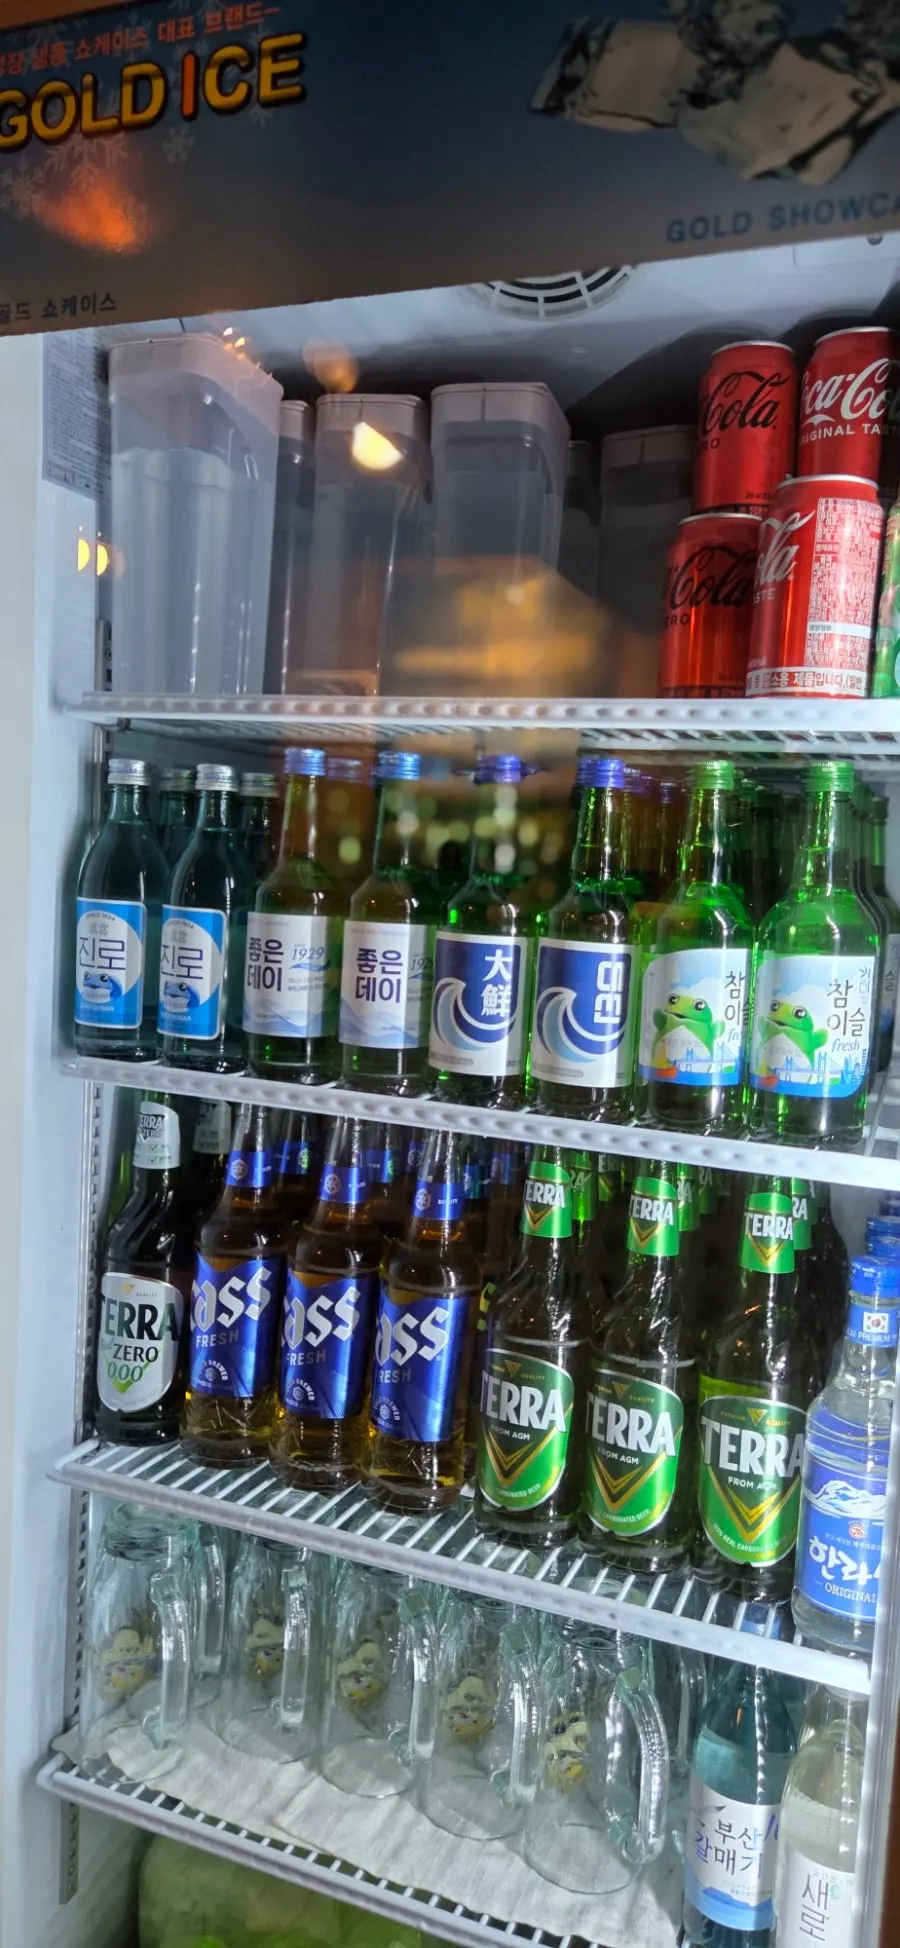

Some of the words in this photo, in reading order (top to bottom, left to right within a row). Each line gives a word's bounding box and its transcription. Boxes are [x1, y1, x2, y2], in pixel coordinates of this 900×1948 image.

[75, 27, 149, 60] 쇼케이스
[158, 16, 196, 43] 대표
[0, 61, 168, 150] GOLD
[181, 32, 306, 118] ICE
[666, 211, 753, 244] GOLD
[41, 292, 117, 318] 쇼케이스
[801, 424, 855, 445] RIGINAL
[79, 937, 126, 971] 진로
[160, 944, 204, 980] 진로
[248, 937, 284, 964] 좋은
[291, 946, 325, 961] 1929
[356, 947, 403, 975] 좋은
[247, 964, 282, 992] 데이
[355, 976, 402, 1003] 데이
[481, 949, 515, 1018] 大鮮
[831, 1038, 860, 1053] fresh
[525, 1179, 566, 1208] TERRA
[629, 1194, 675, 1226] TERRA
[744, 1211, 794, 1240] TERRA
[196, 1329, 239, 1349] FRESH
[374, 1306, 450, 1367] ass
[112, 1343, 159, 1364] ZERO
[378, 1369, 412, 1384] RESH
[490, 1424, 511, 1437] FROM
[512, 1430, 531, 1441] AGM
[701, 1415, 805, 1478] TERRA
[597, 1446, 618, 1461] FROM
[619, 1454, 640, 1465] AGM
[728, 1476, 755, 1489] FROM
[809, 1535, 881, 1586] 한라
[824, 1582, 878, 1603] ORIGINAL
[713, 1818, 763, 1851] 부산
[694, 1831, 764, 1879] 갈매기
